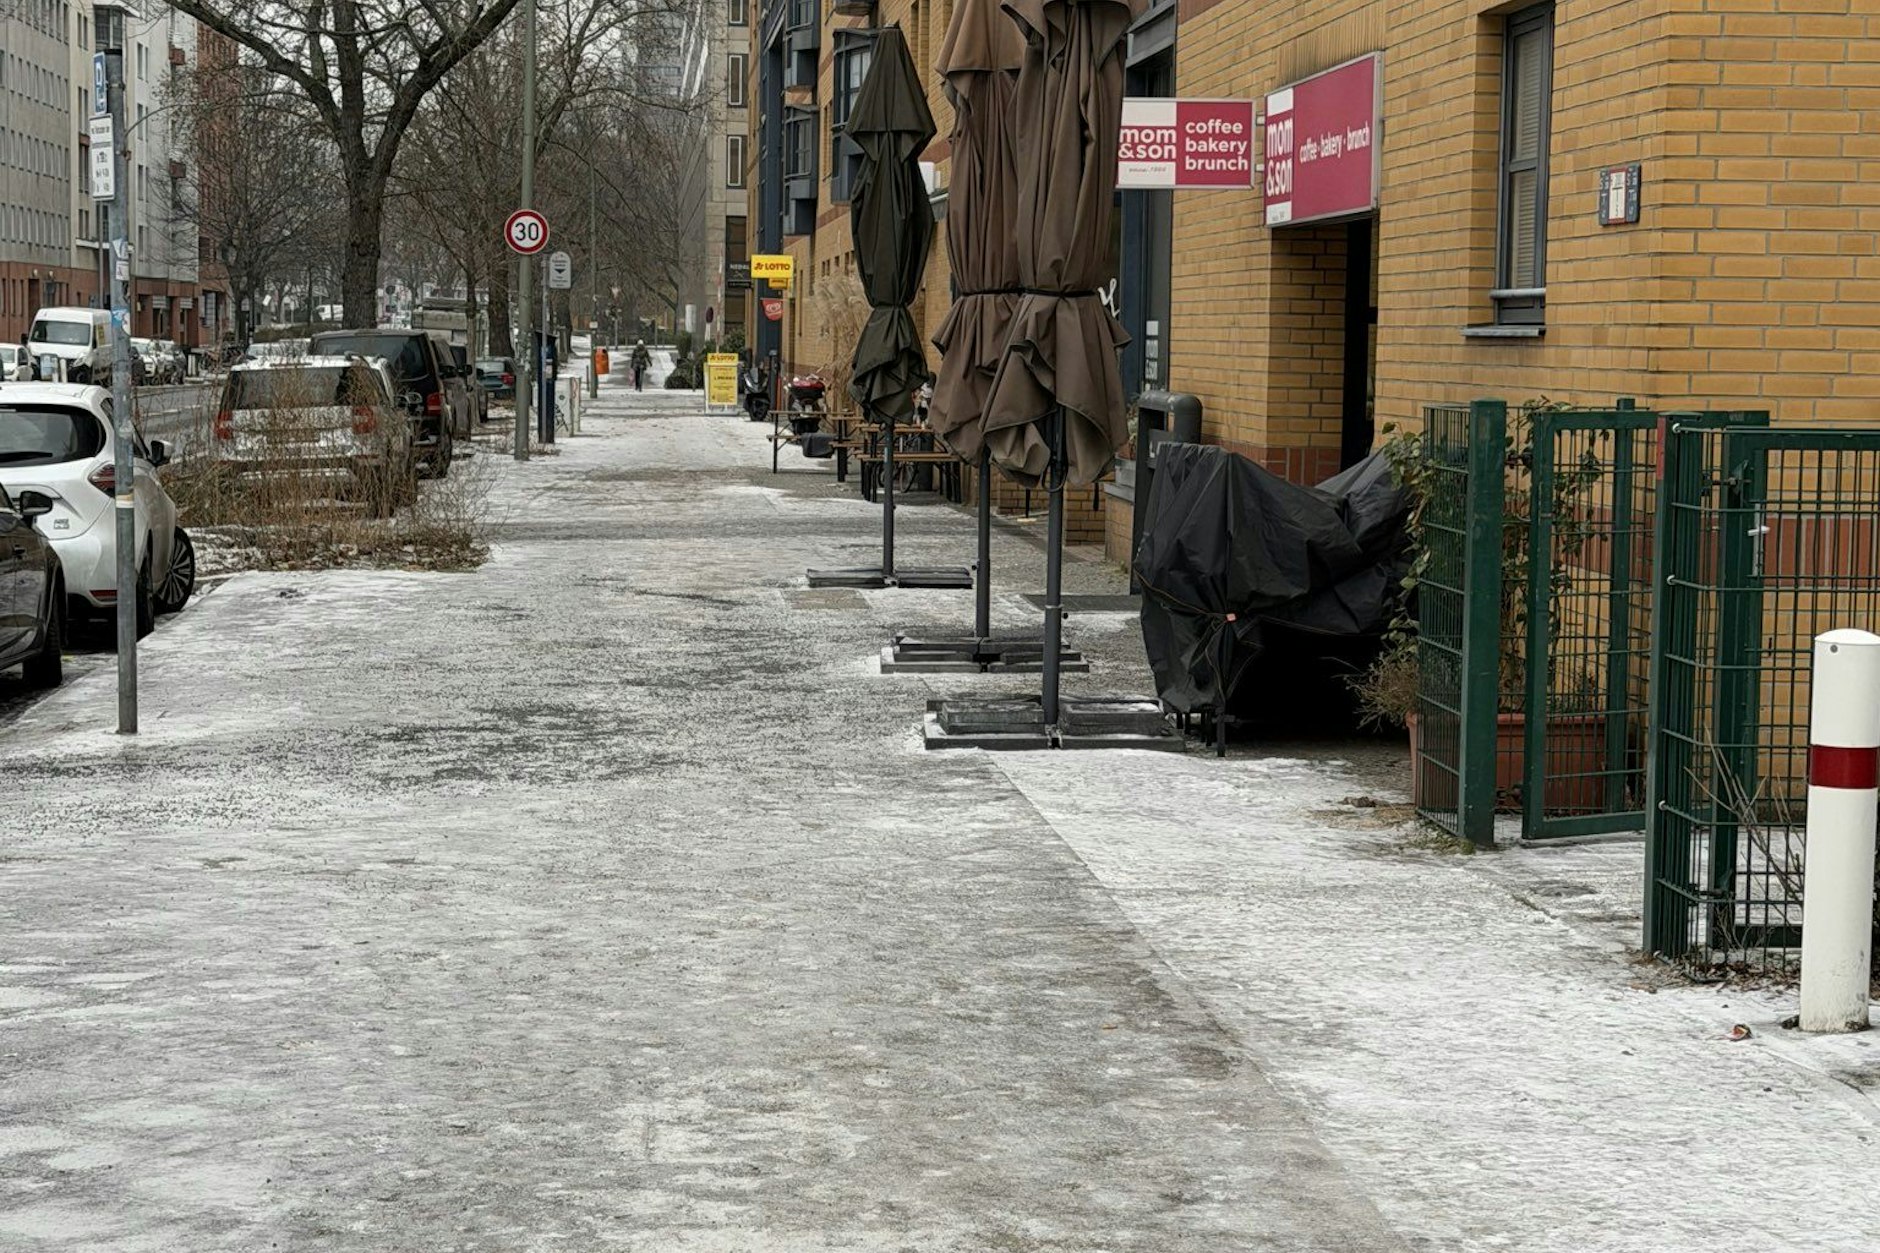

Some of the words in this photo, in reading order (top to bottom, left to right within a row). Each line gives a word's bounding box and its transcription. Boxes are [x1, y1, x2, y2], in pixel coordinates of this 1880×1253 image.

[1185, 118, 1243, 134] coffee
[1119, 128, 1177, 143] mom
[1267, 117, 1293, 158] mom
[1299, 137, 1318, 164] coffee
[1320, 131, 1343, 159] bakery
[1346, 120, 1370, 151] brunch
[1118, 143, 1177, 159] &son
[1185, 137, 1247, 155] bakery
[1185, 155, 1248, 171] brunch
[1266, 158, 1292, 197] &son
[514, 222, 539, 242] 30
[765, 262, 791, 271] LOTTO
